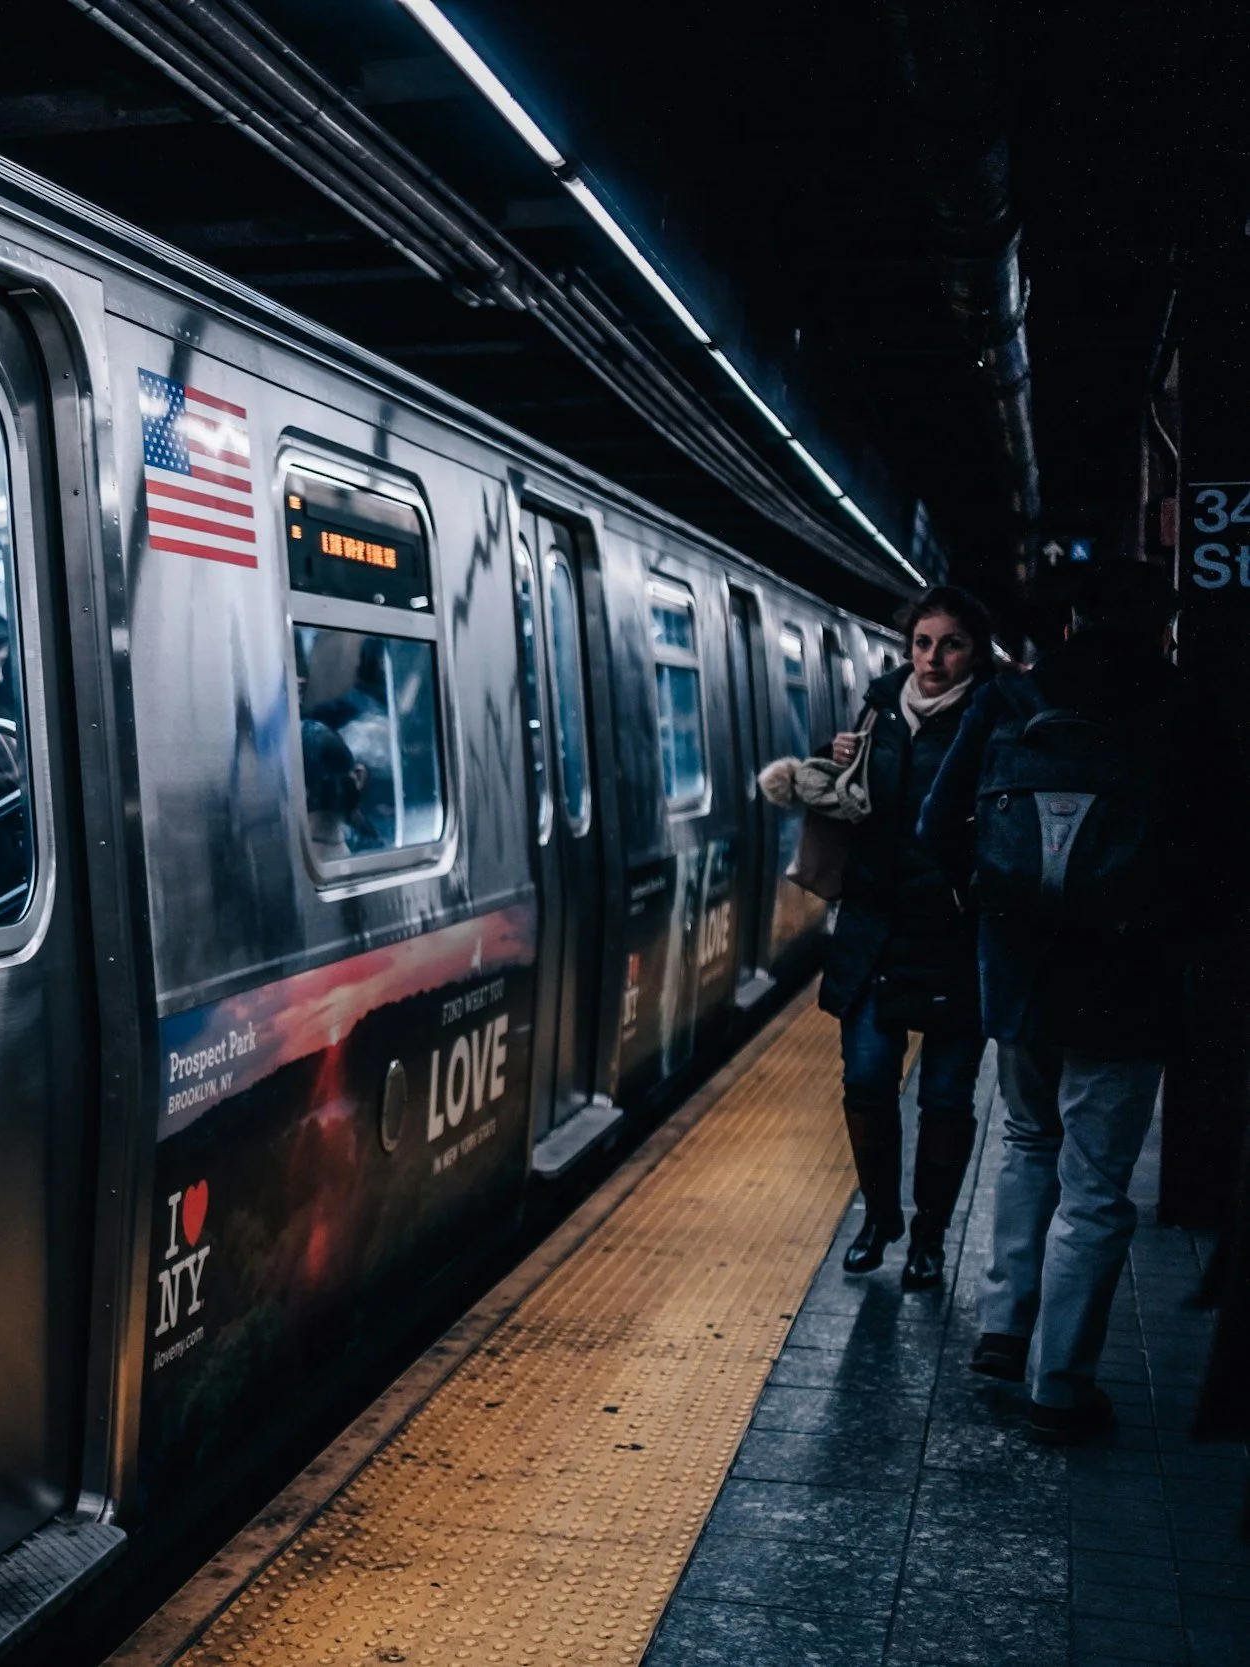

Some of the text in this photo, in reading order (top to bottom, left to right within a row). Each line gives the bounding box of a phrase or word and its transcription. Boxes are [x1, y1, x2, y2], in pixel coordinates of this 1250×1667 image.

[169, 1021, 257, 1083] Prospect Park
[427, 1012, 510, 1142] LOVE
[167, 1071, 235, 1115] BROOKLYN, NY
[165, 1190, 183, 1261] I
[154, 1244, 212, 1338] NY
[152, 1325, 205, 1372] iloveny.com
